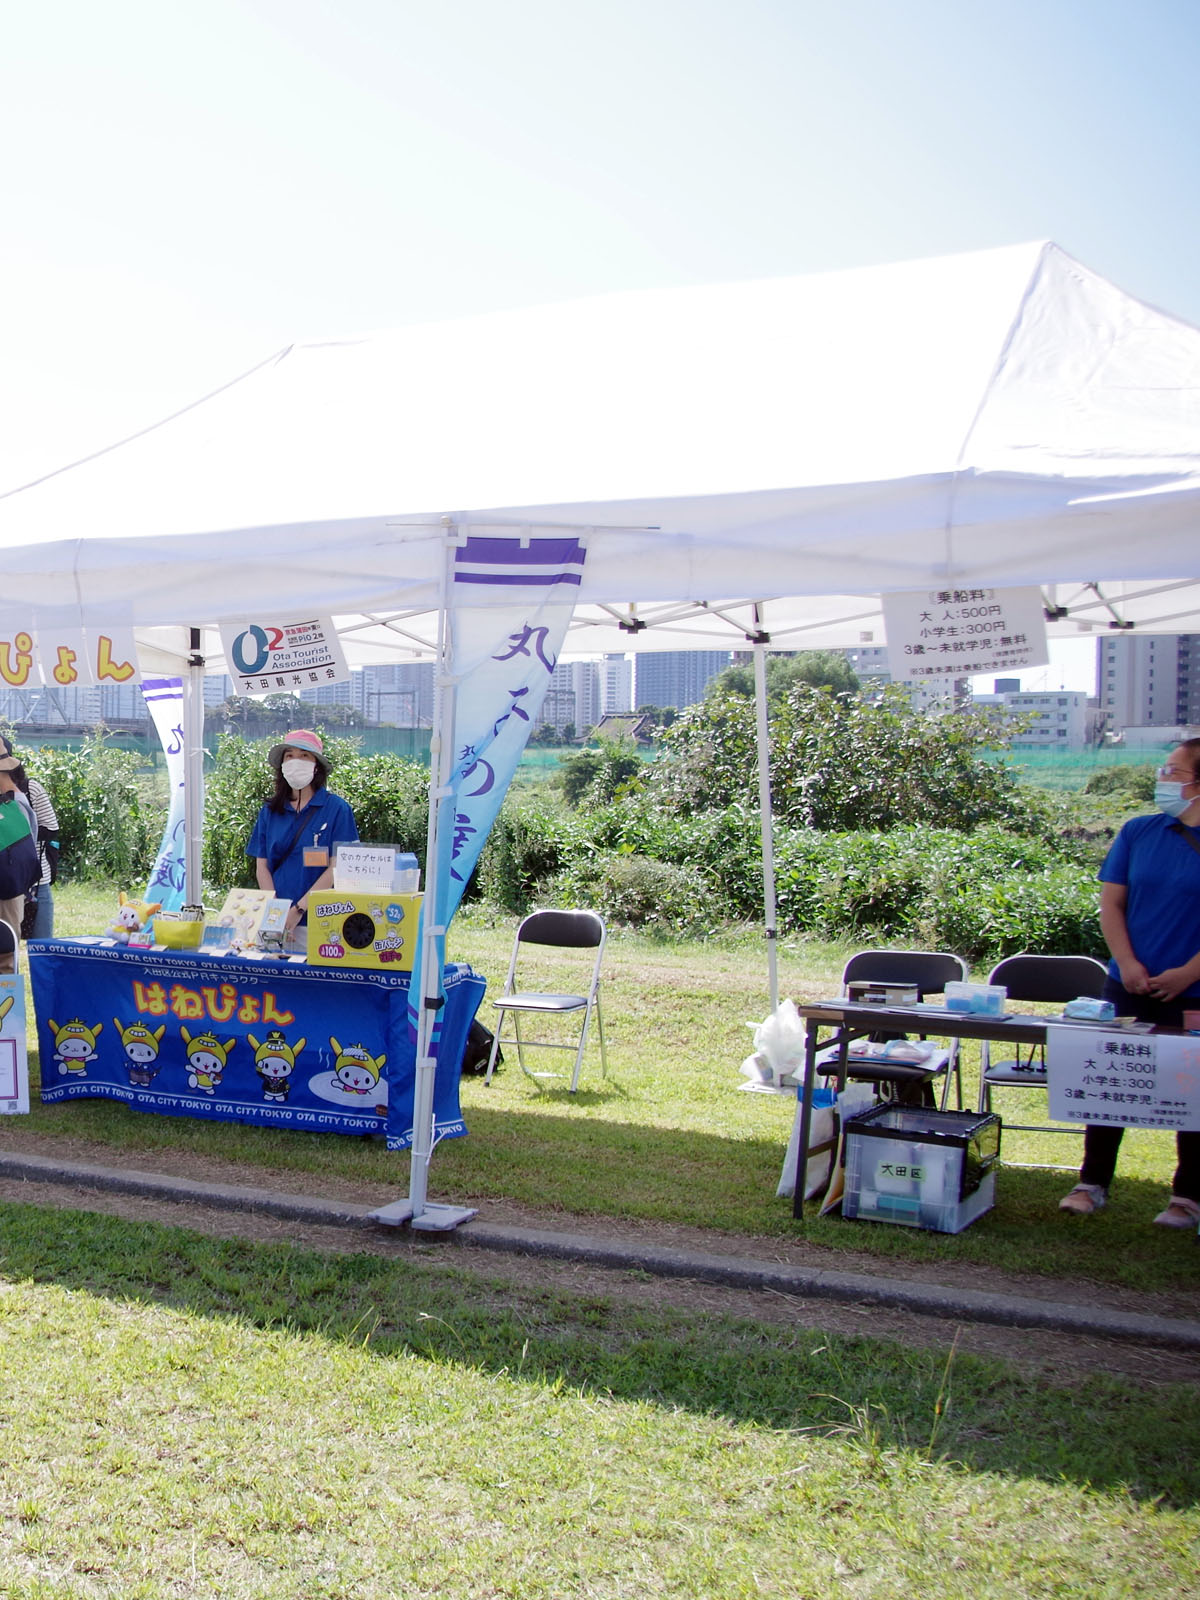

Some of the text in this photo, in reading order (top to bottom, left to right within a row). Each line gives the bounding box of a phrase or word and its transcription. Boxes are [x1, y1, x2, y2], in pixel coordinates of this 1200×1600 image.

[271, 654, 332, 670] Association
[273, 645, 329, 661] Ota Tourist
[244, 668, 336, 690] 大田観光協会
[49, 945, 67, 953] OTA
[67, 946, 88, 955] CITY
[89, 948, 119, 959] TOKYO
[123, 954, 142, 962] OTA
[143, 956, 164, 965] CITY
[165, 958, 197, 968] TOKYO
[201, 962, 220, 970] OTA
[221, 964, 244, 973] CITY
[245, 966, 279, 976] TOKYO
[283, 969, 302, 977] OTA
[304, 970, 327, 979] CITY
[329, 972, 364, 982] TOKYO
[369, 975, 388, 985] OTA
[390, 977, 412, 987] CIT
[133, 980, 296, 1026] はねぴょん
[68, 1086, 88, 1095] OTA
[90, 1085, 110, 1095] CITY
[111, 1088, 134, 1100] TOKYO
[137, 1094, 156, 1104] OTA
[157, 1097, 178, 1107] CITY
[180, 1100, 211, 1111] TOKYO
[215, 1104, 234, 1113] OTA
[236, 1107, 258, 1116] CITY
[259, 1108, 293, 1120] TOKYO
[296, 1113, 316, 1122] OTA
[318, 1115, 341, 1125] CITY
[343, 1117, 378, 1129] TOKYO
[881, 1163, 922, 1179] 大田区
